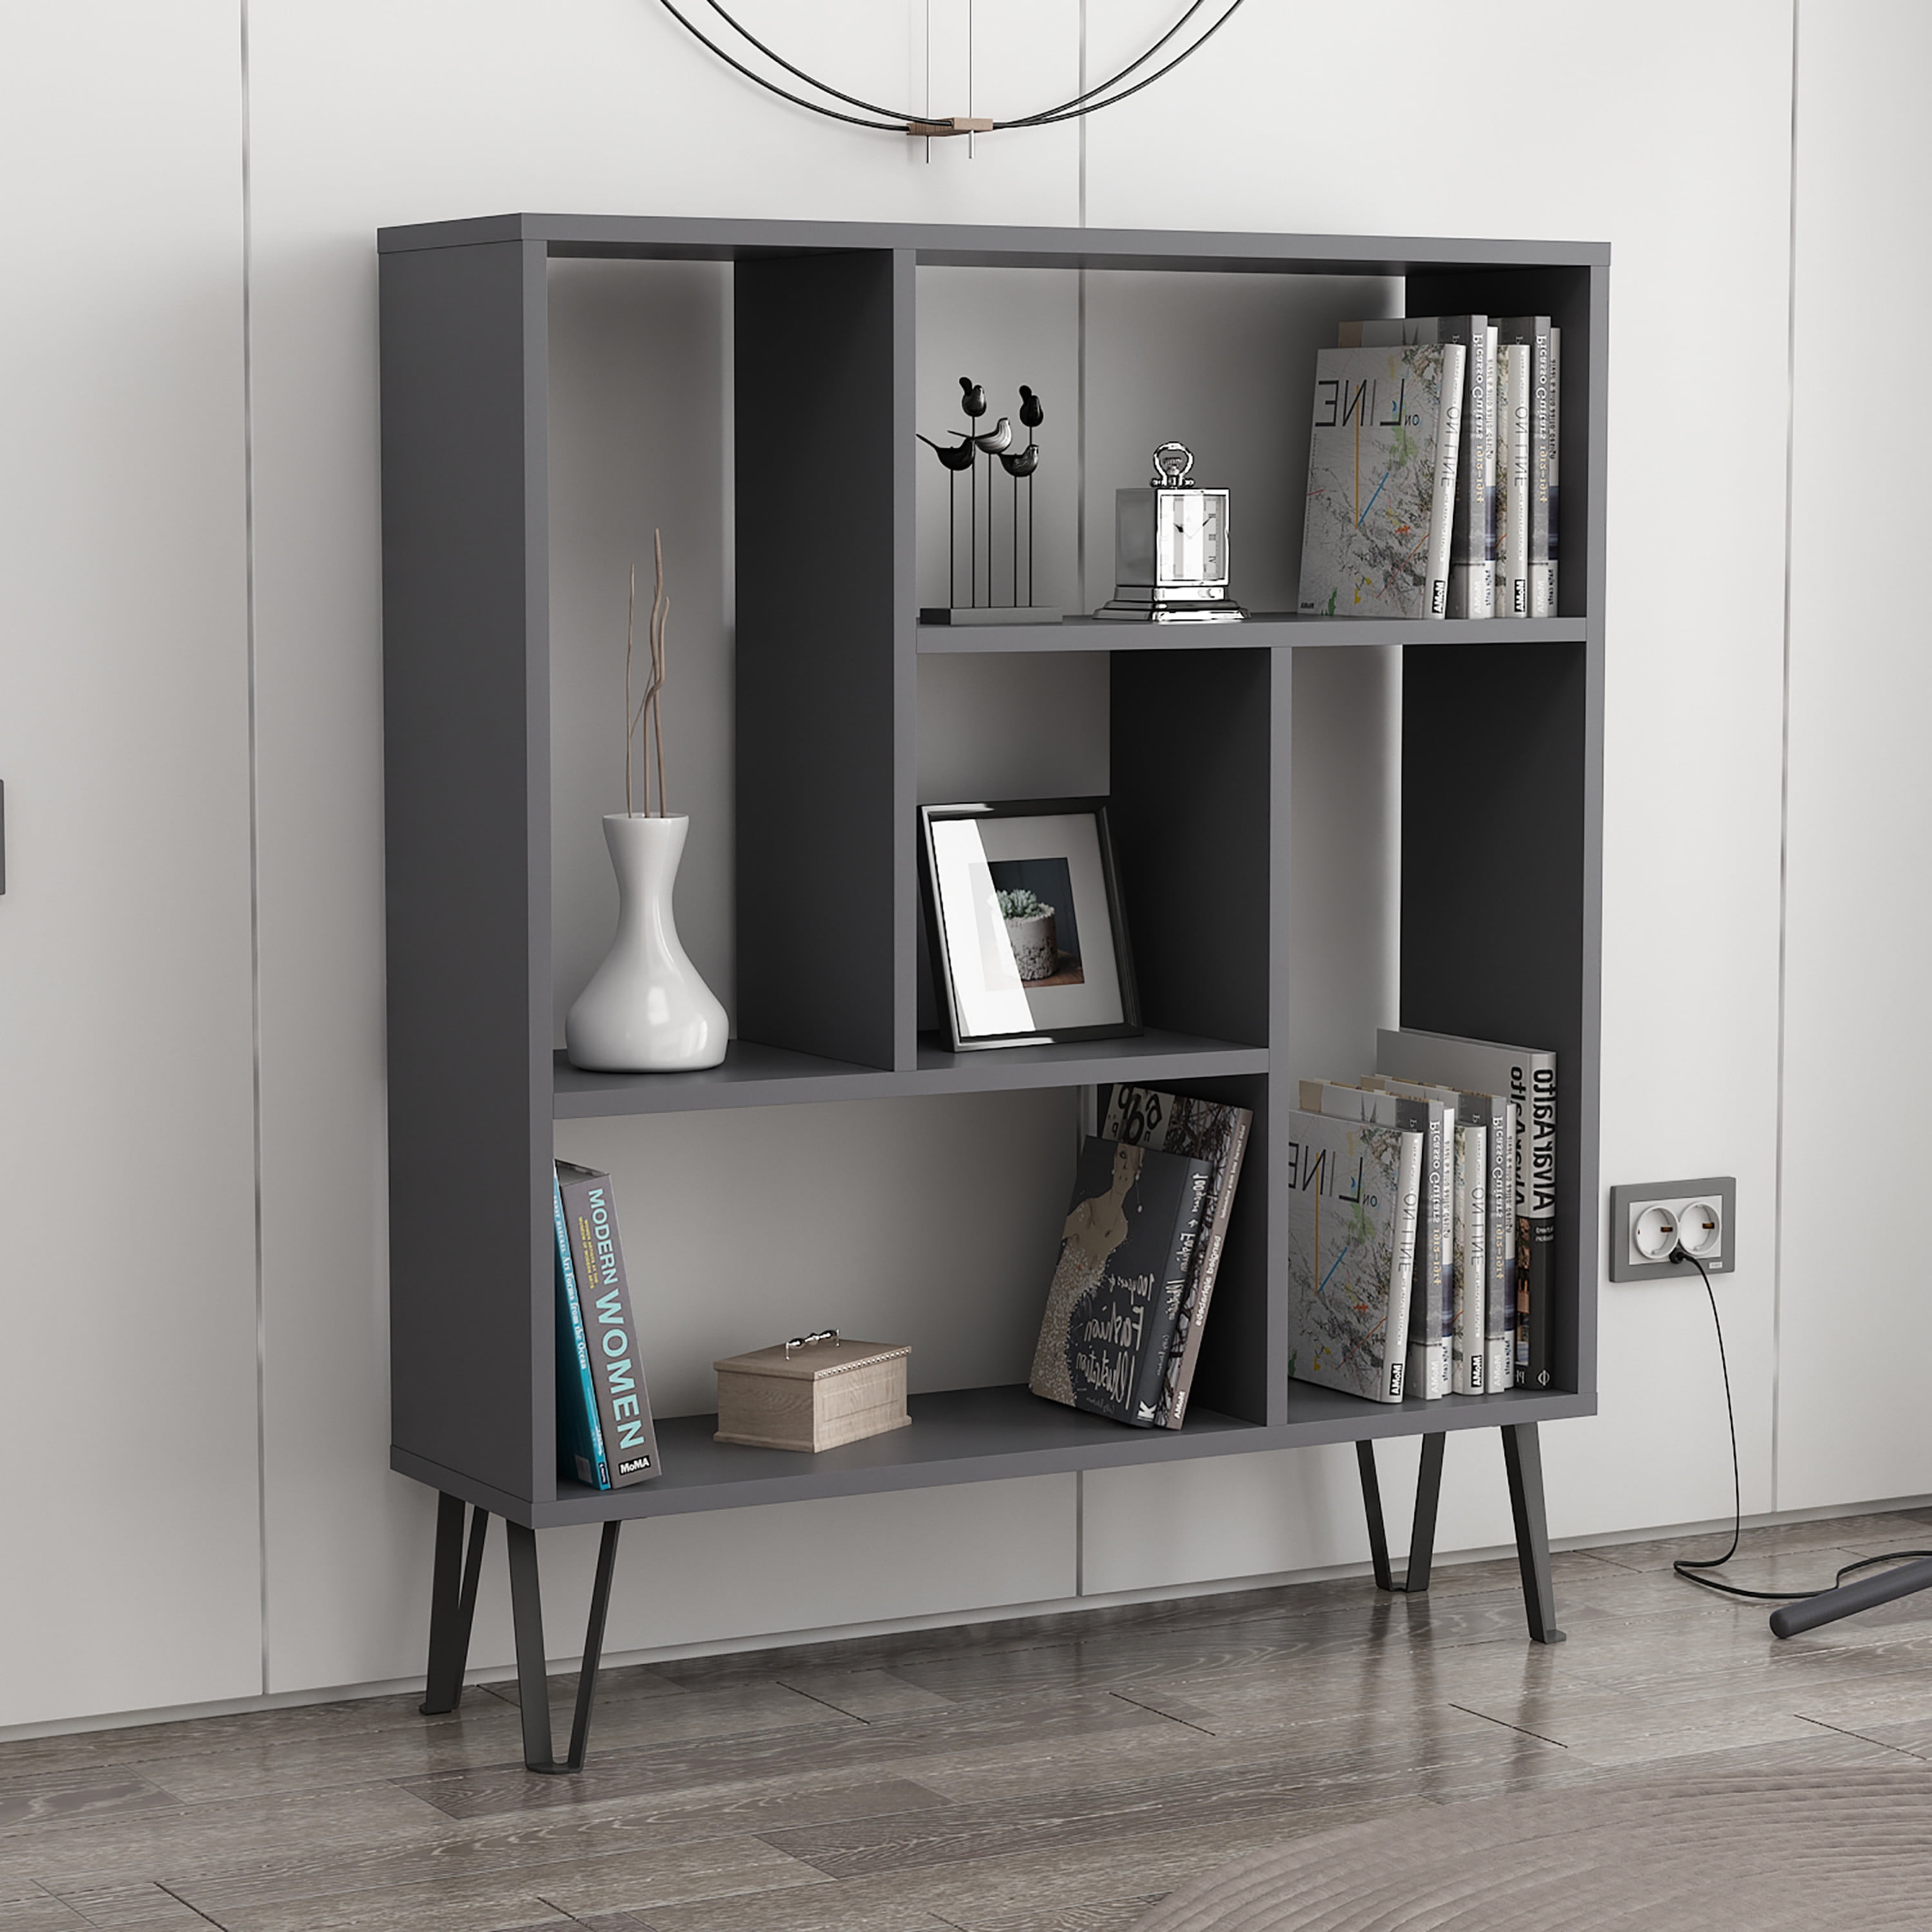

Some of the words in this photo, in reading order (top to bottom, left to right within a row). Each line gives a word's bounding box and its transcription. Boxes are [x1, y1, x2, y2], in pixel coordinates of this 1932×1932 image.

[588, 1188, 619, 1285] MODERN
[596, 1288, 645, 1450] WOMEN
[620, 1457, 650, 1475] MoMA
